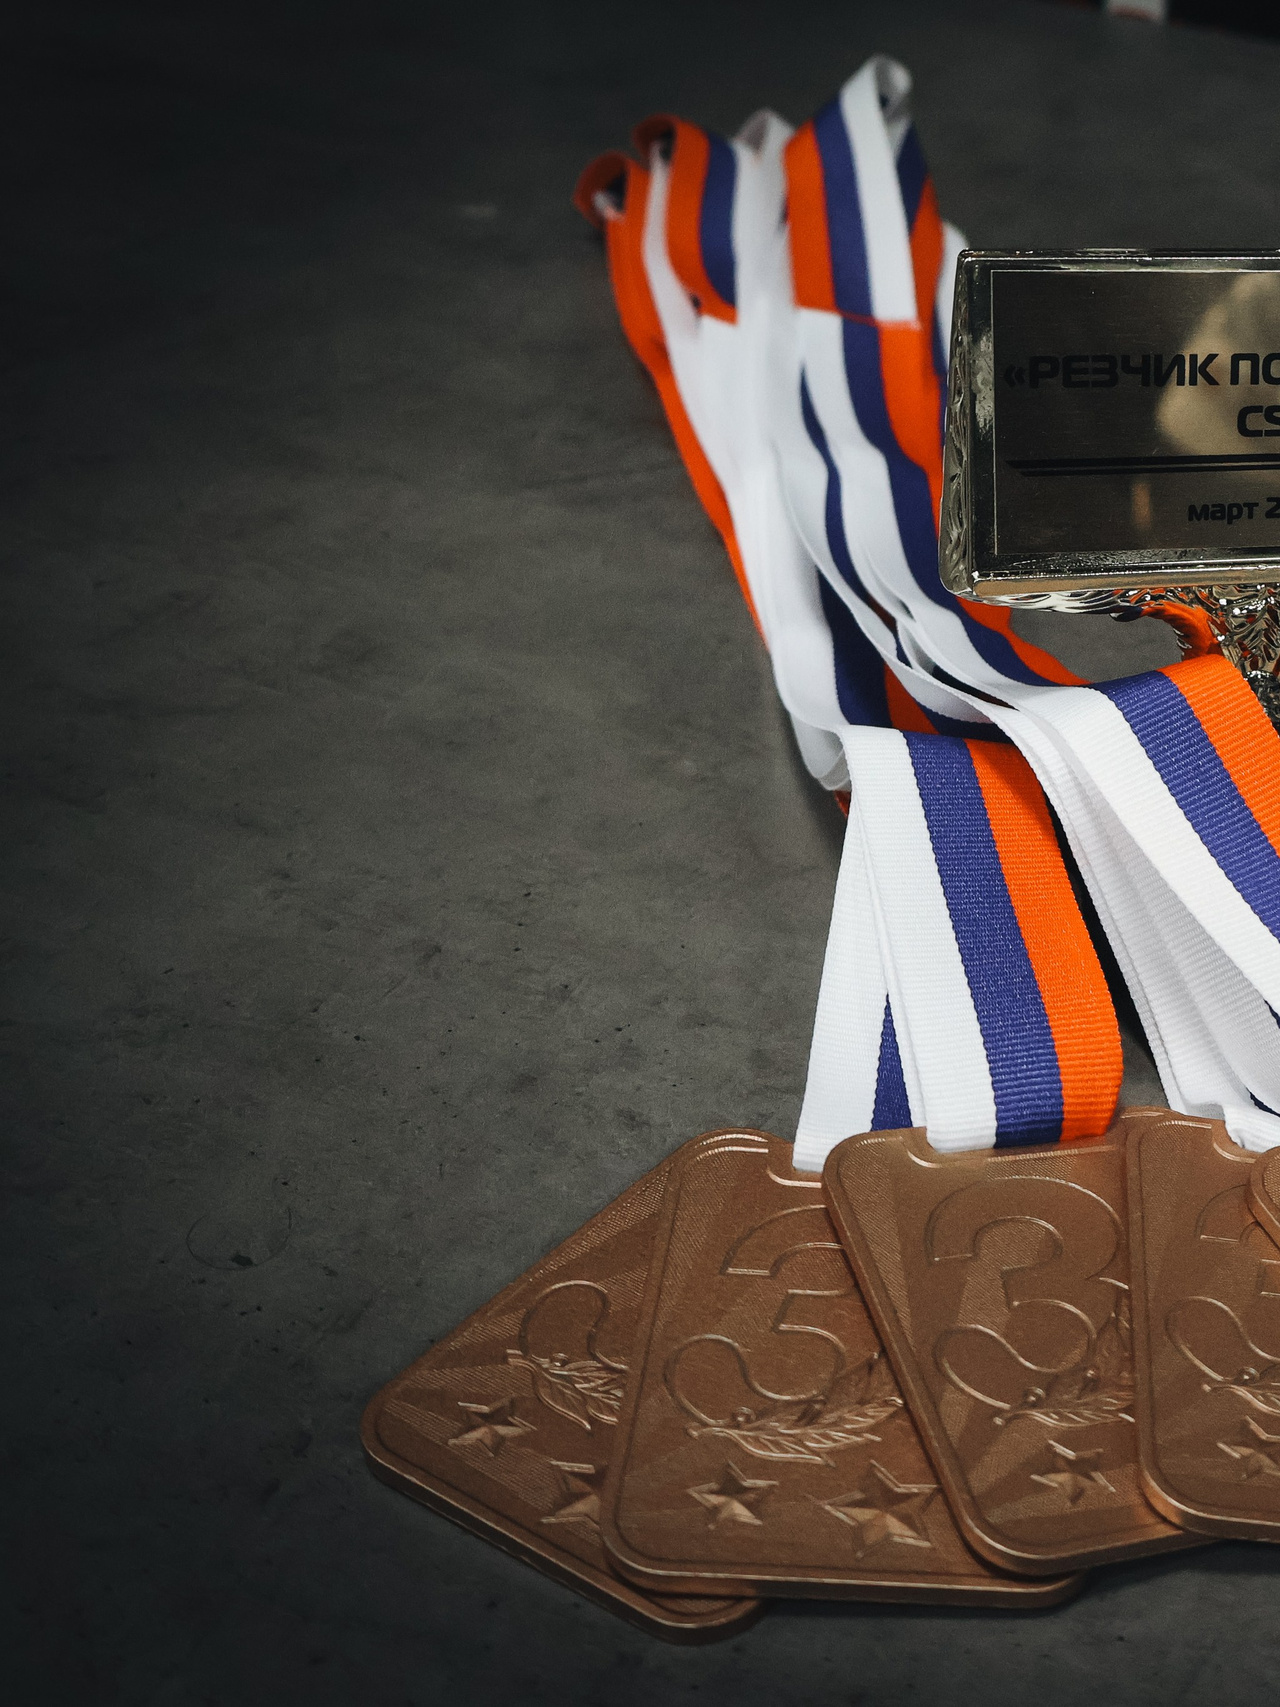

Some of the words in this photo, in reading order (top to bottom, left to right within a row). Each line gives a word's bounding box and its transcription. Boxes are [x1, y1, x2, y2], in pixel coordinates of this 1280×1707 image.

[1003, 353, 1220, 388] «РЕЗЧИК
[1187, 500, 1259, 524] март
[925, 1175, 1128, 1412] 3
